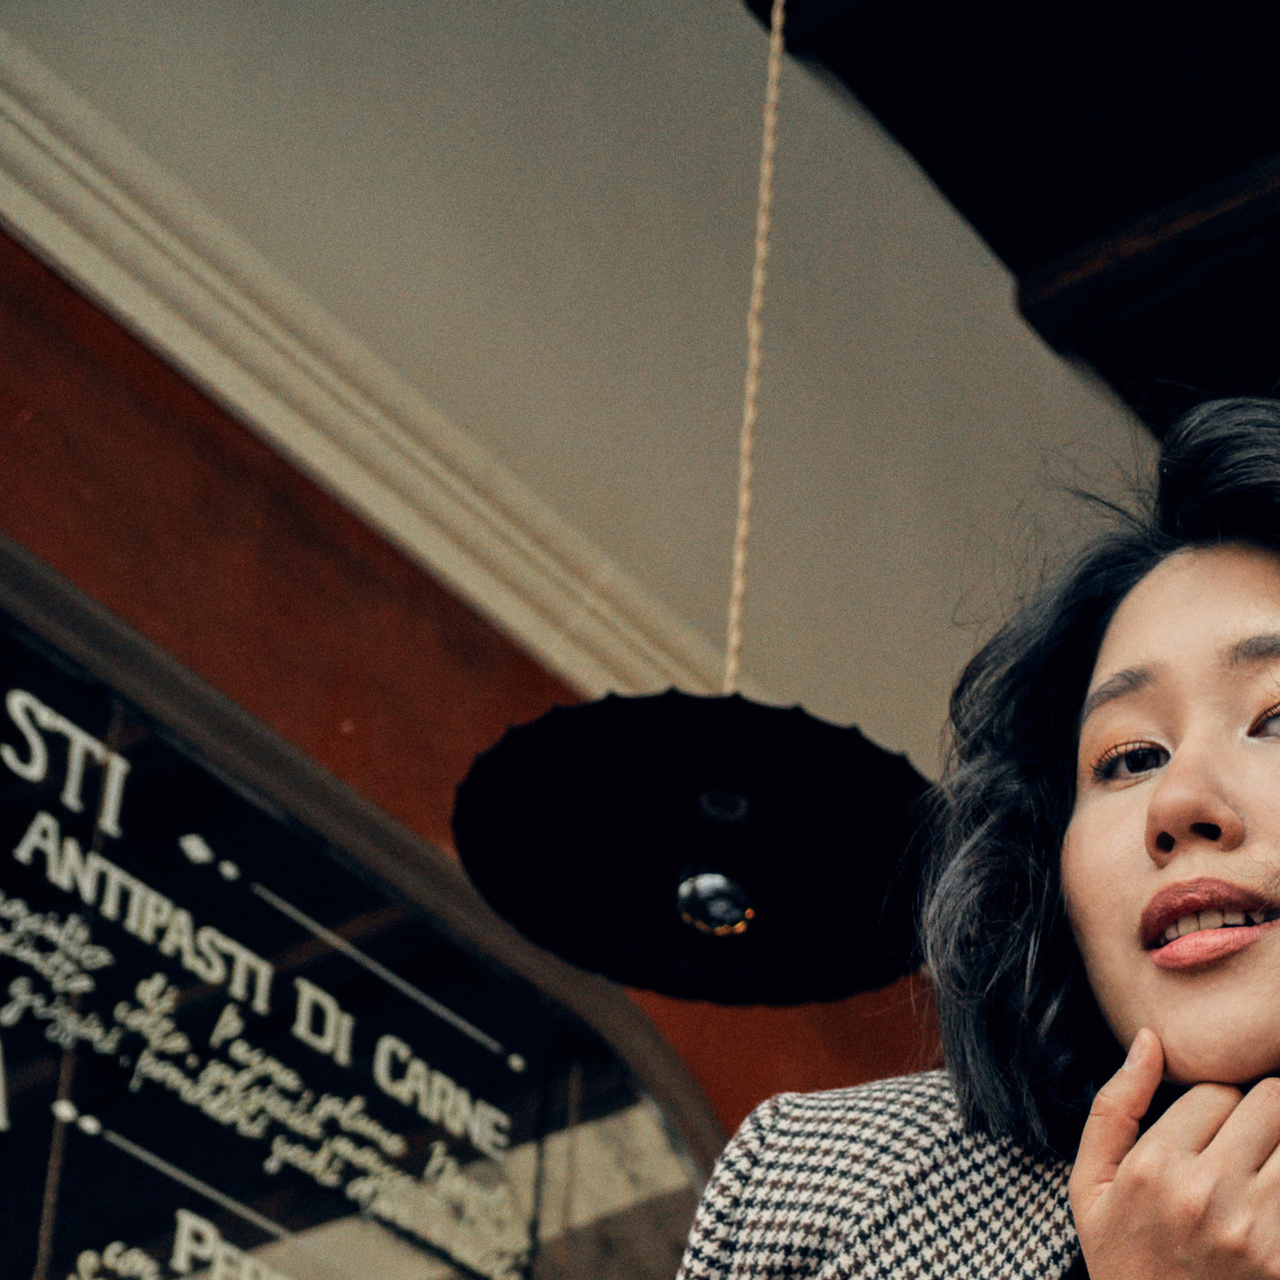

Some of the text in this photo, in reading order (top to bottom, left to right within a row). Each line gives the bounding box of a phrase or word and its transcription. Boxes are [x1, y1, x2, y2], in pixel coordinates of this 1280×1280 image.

[0, 689, 131, 838] STI
[12, 811, 274, 1016] ANTIPASTI
[290, 972, 356, 1067] DI
[373, 1034, 512, 1160] CARNE
